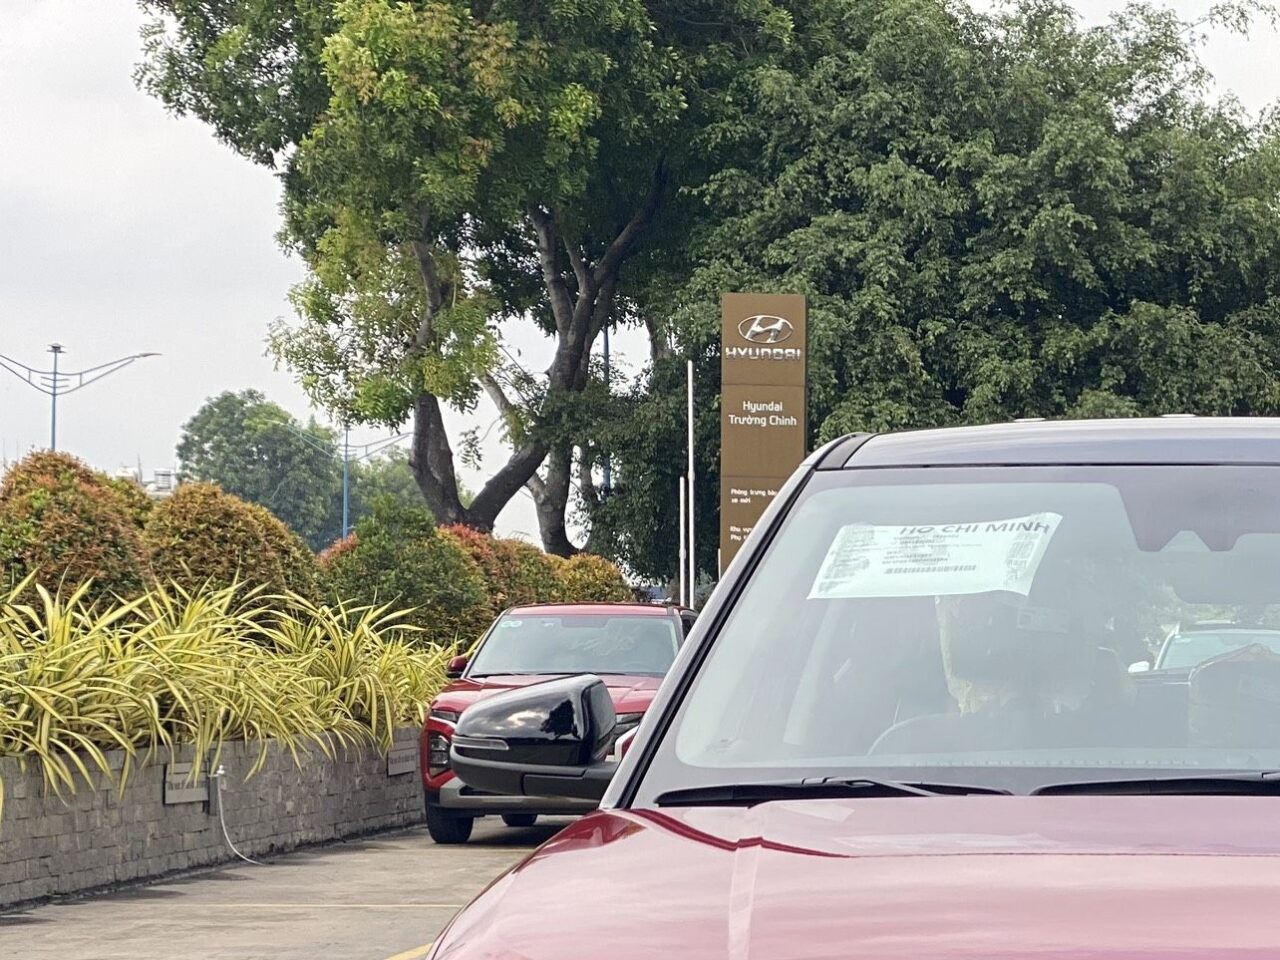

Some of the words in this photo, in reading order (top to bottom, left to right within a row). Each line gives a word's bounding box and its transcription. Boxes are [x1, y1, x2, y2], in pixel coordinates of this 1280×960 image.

[725, 347, 801, 360] HYUNDAI
[742, 401, 783, 413] Hyundai
[728, 414, 767, 427] Trường
[942, 524, 979, 534] CHI
[984, 521, 1050, 535] MINH
